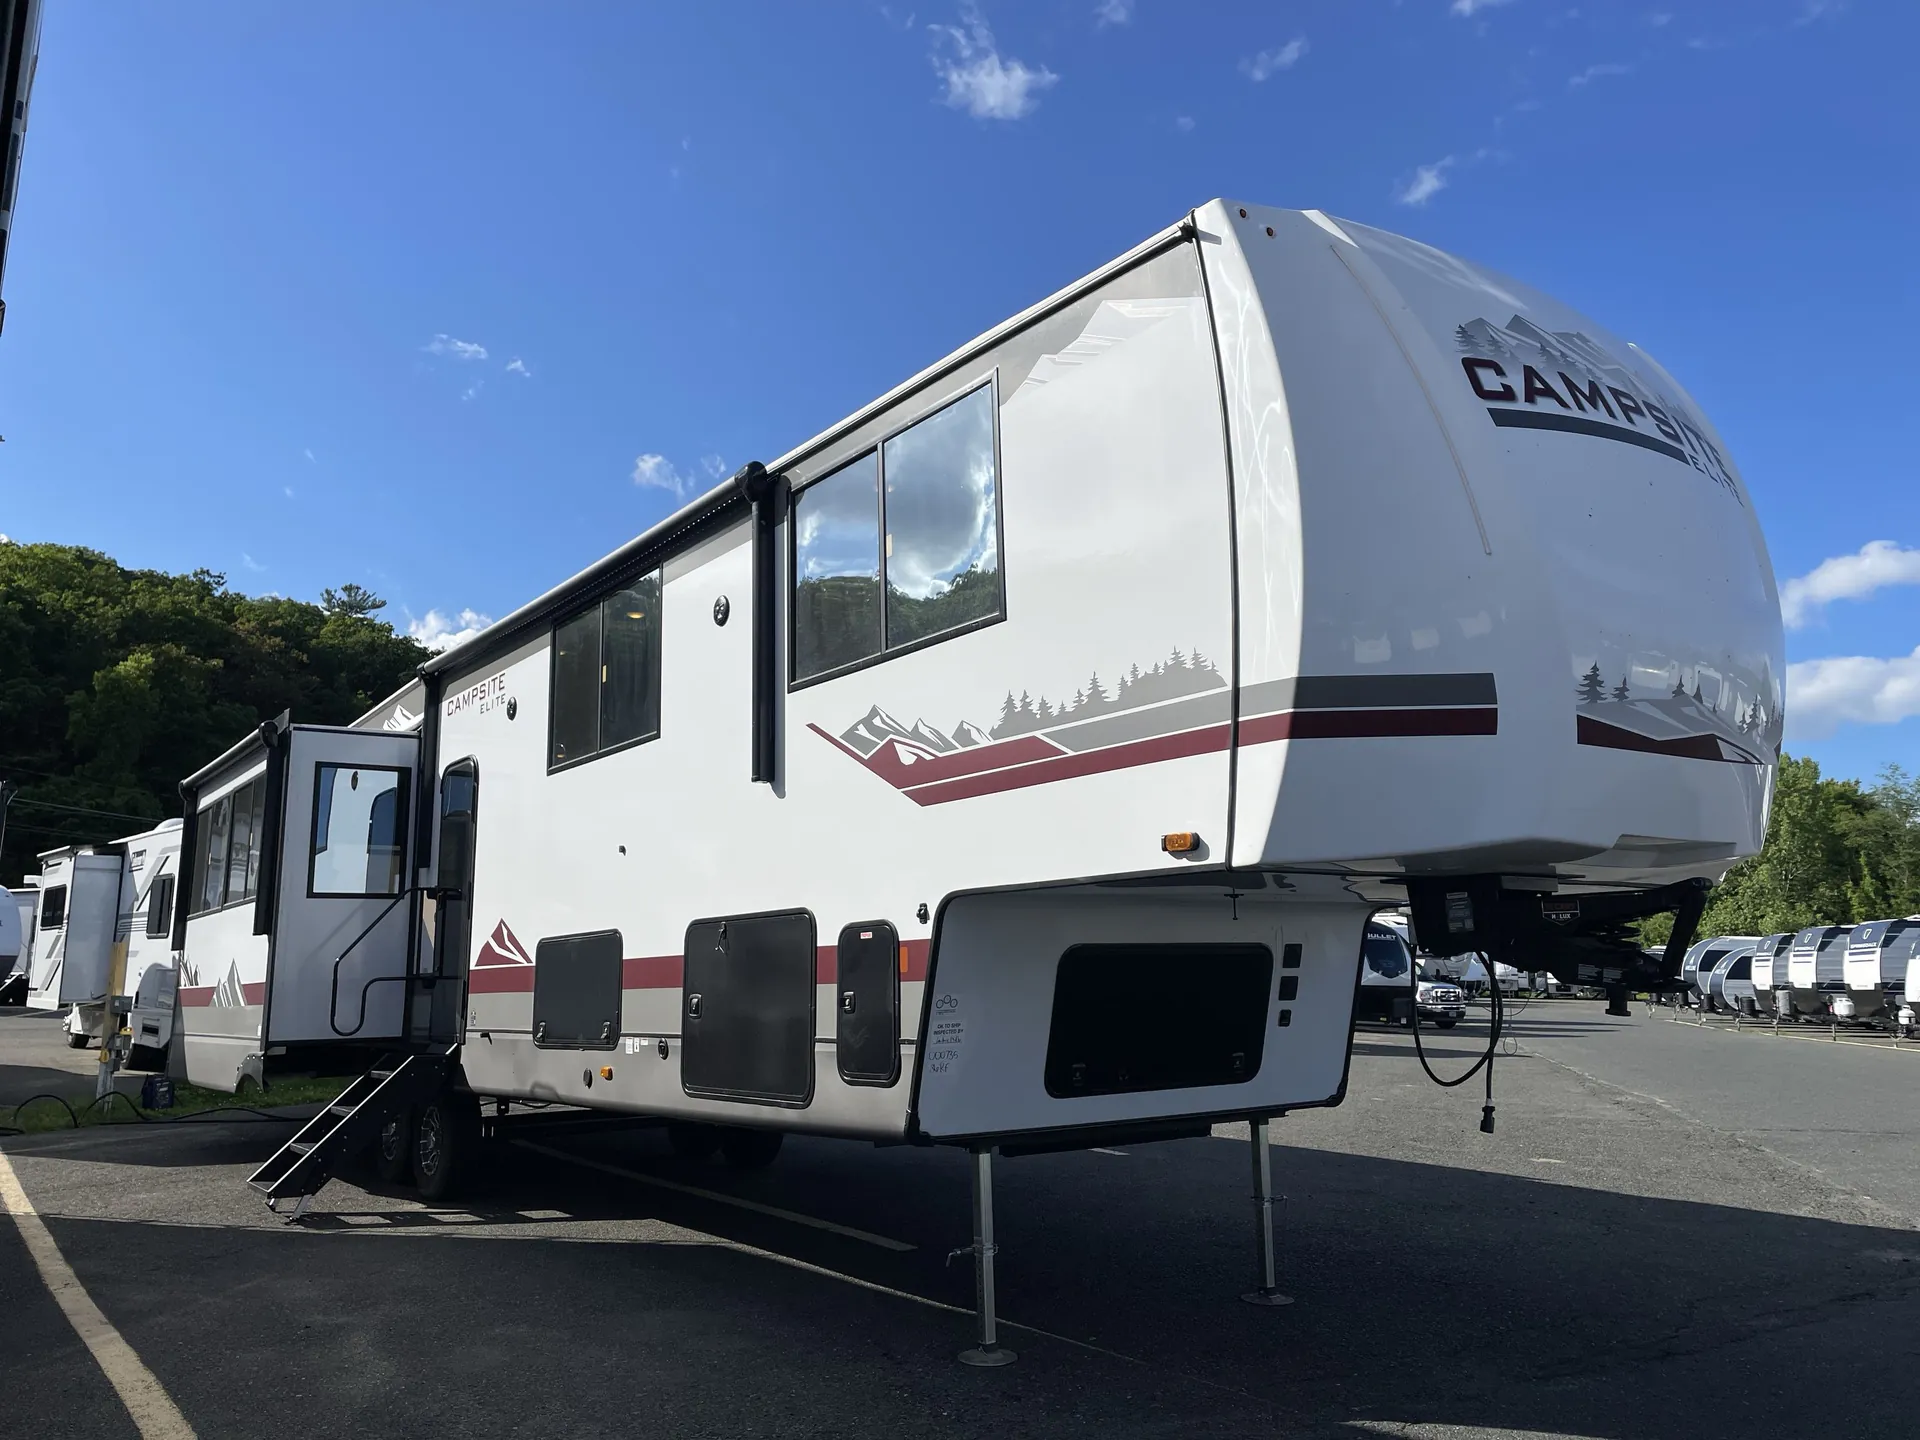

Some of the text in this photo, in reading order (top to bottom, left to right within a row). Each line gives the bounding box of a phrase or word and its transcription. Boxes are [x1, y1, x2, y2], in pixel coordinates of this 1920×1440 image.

[1461, 356, 1736, 486] CAMPSITE
[1688, 453, 1744, 507] ELITE
[447, 672, 506, 716] CAMPSITE
[479, 693, 506, 714] ELITE
